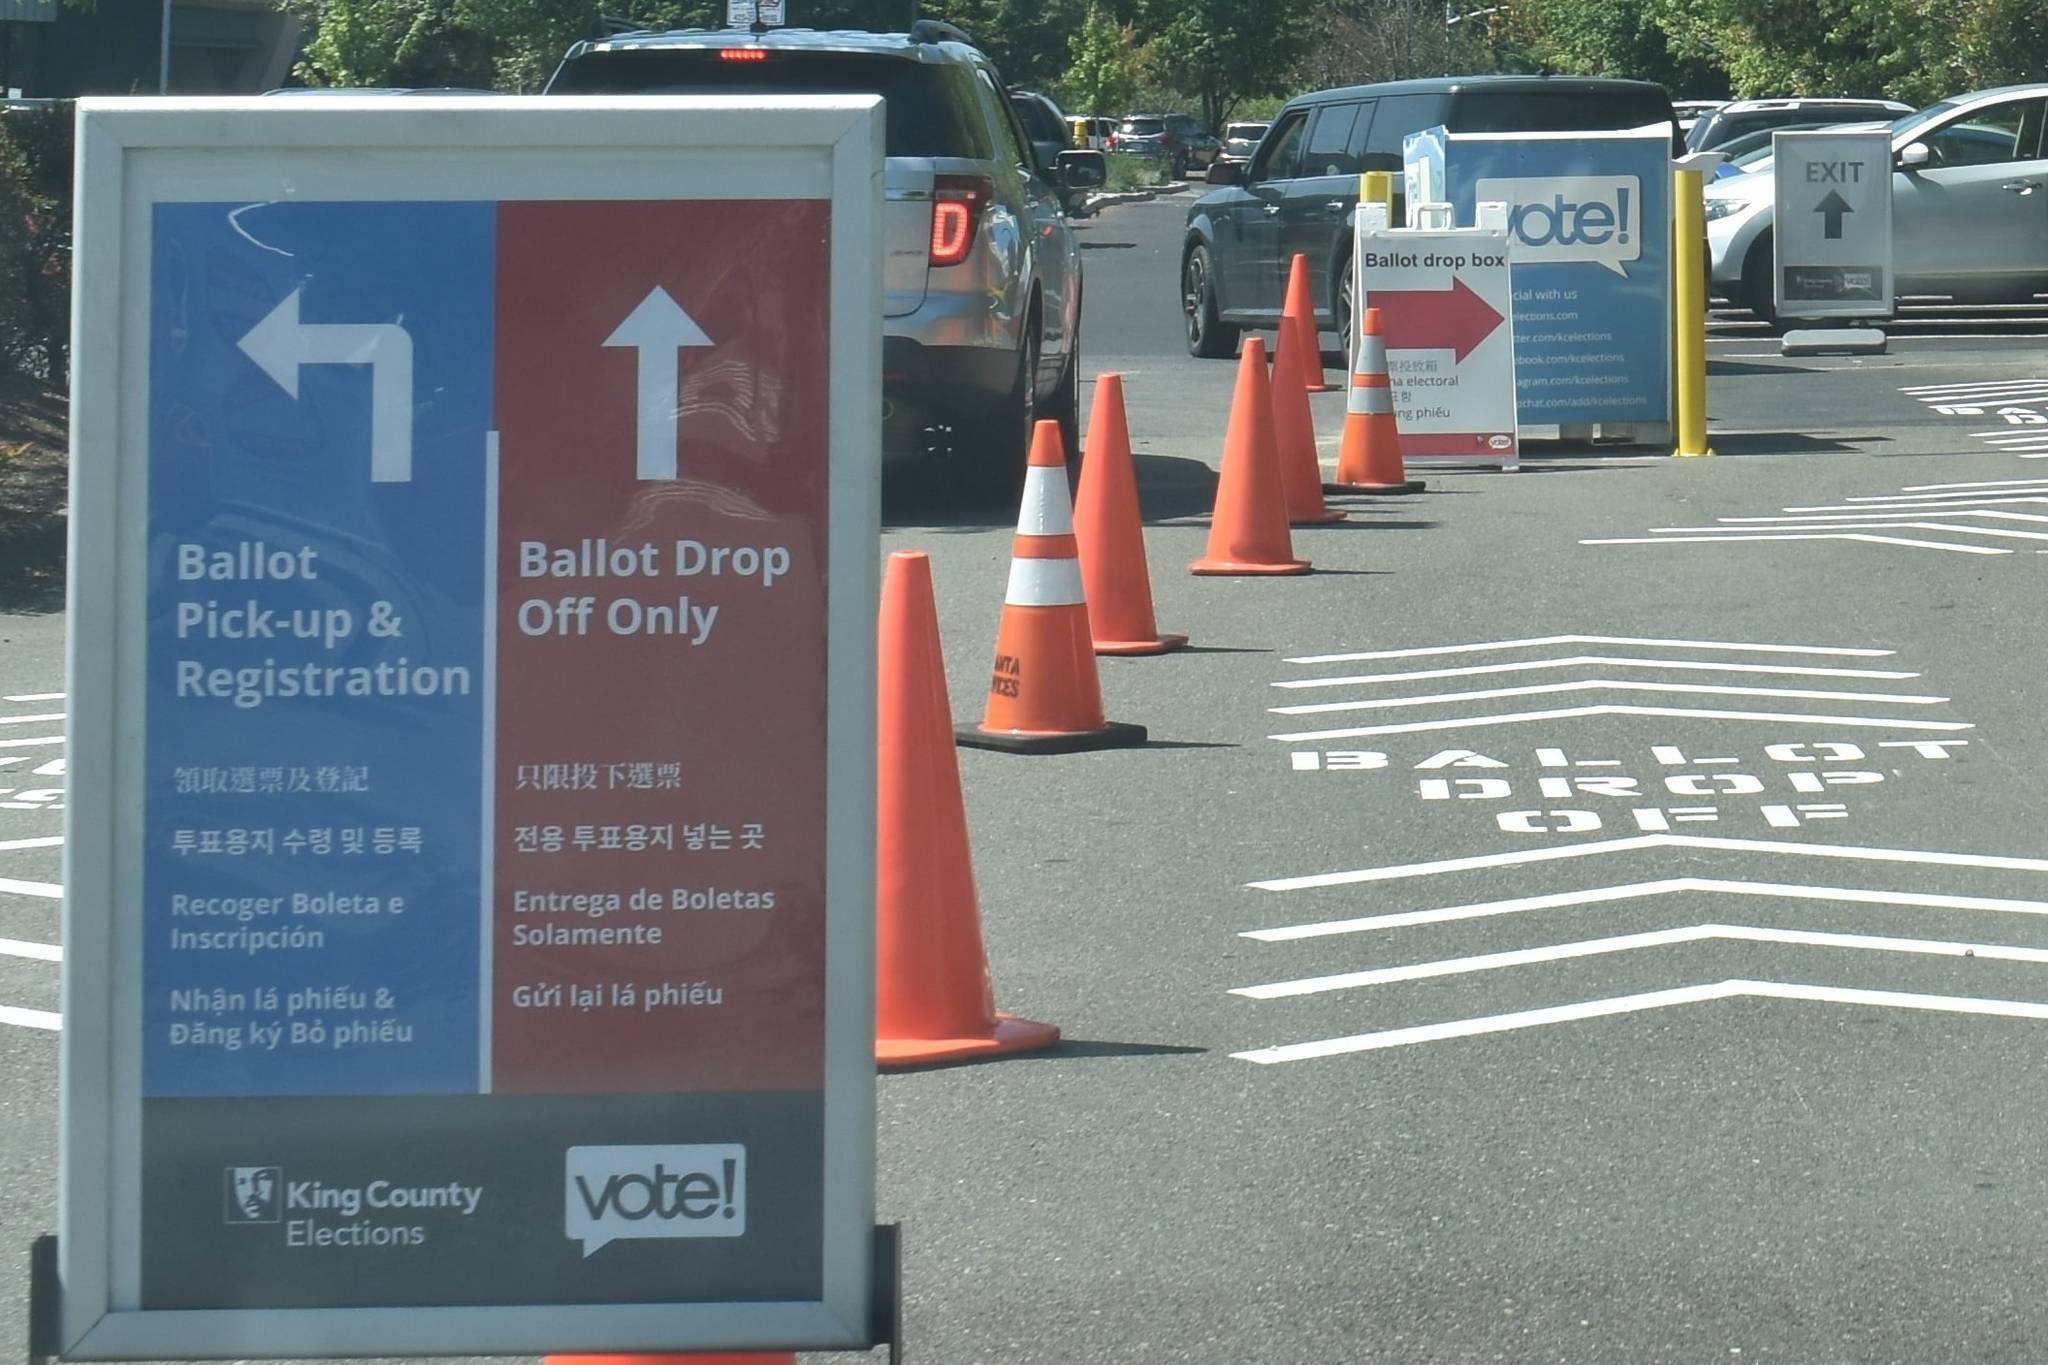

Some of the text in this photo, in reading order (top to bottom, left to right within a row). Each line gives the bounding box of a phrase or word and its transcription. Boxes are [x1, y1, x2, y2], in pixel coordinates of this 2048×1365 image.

[1806, 162, 1864, 183] EXIT
[1365, 252, 1505, 270] Ballot drop box
[1513, 288, 1578, 301] cial with us
[1515, 352, 1624, 365] book.com/kcelections
[1407, 375, 1459, 387] electoral
[1516, 374, 1629, 388] agram.com/kcelections
[177, 542, 318, 580] Ballot
[520, 538, 790, 587] Ballot Drop
[177, 600, 402, 649] Pick-up &
[518, 596, 719, 645] Off Only
[176, 657, 471, 708] Registration
[1290, 740, 1969, 770] BALLOT
[173, 766, 369, 793] 領取選票及登記
[515, 762, 681, 790] 只限投下選票
[1420, 772, 1886, 799] DROP
[1496, 804, 1848, 833] OFF
[171, 827, 423, 855] 투표용지 수령 및 등록
[514, 824, 765, 852] 전용 투표용지 넣는 곳
[171, 891, 405, 922] Recoger Boleta e
[514, 887, 775, 918] Entrega de Boletas
[171, 925, 324, 956] Inscripción
[513, 924, 662, 946] Solamente
[170, 984, 395, 1017] Nhận lá phiếu &
[512, 980, 723, 1012] Gửi lại lá phiếu
[169, 1017, 413, 1051] Đăng ký Bỏ phiếu
[287, 1180, 483, 1217] King County
[575, 1158, 736, 1221] vote!
[287, 1218, 425, 1247] Elections
